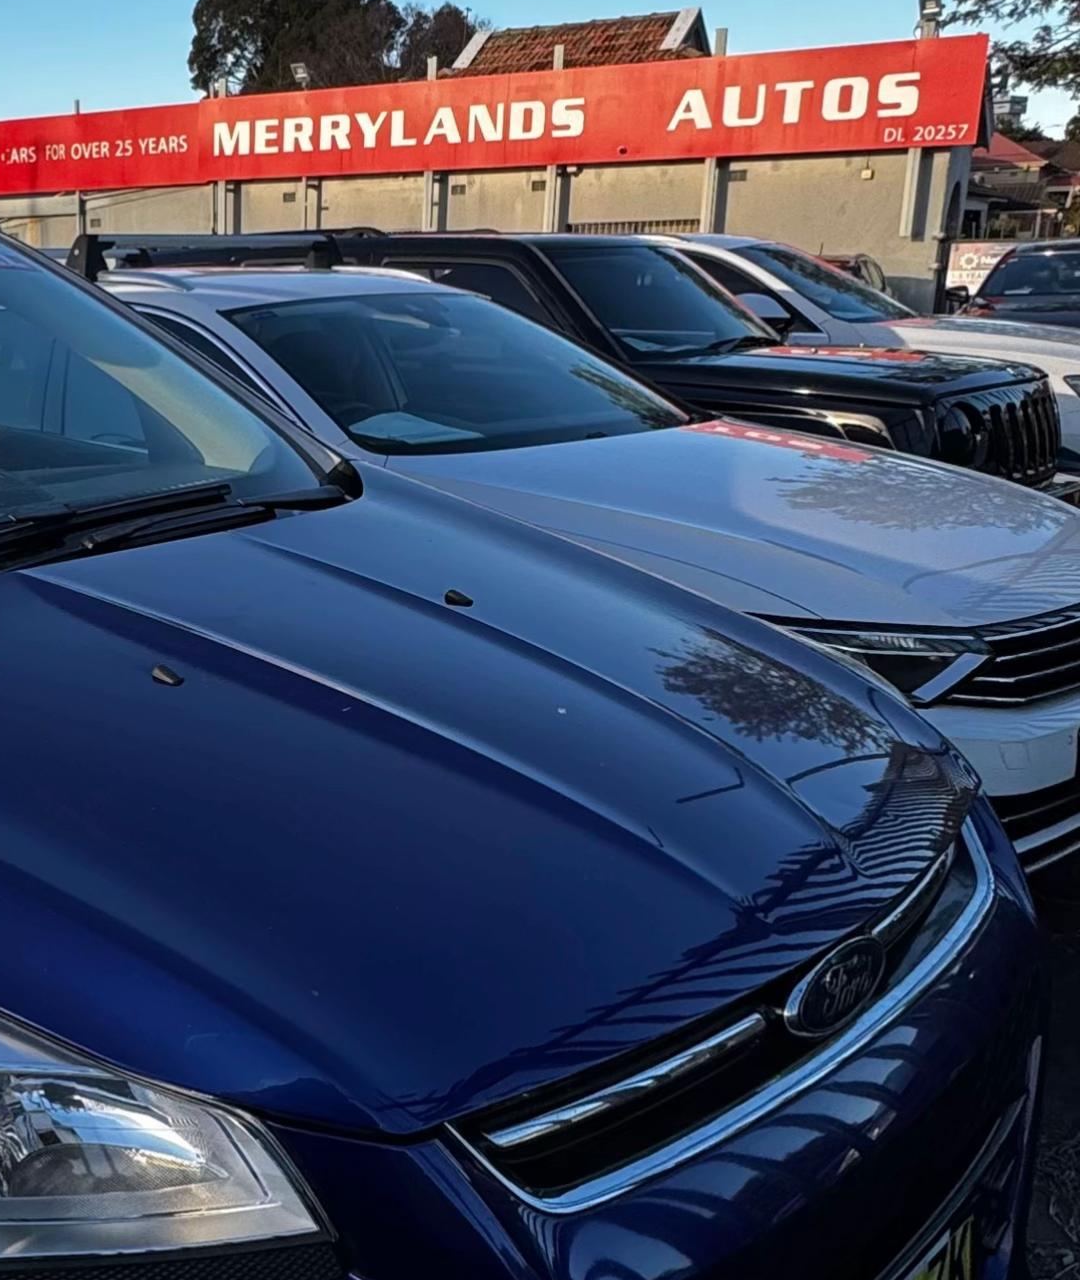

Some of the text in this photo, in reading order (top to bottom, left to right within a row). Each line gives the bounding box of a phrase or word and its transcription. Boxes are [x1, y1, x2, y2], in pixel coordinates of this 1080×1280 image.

[212, 71, 921, 157] MERRYLANDS AUTOS
[883, 123, 969, 144] DL 20257
[45, 143, 66, 161] FOR
[71, 140, 110, 160] OVER
[115, 139, 133, 157] 25
[138, 134, 188, 155] YEARS
